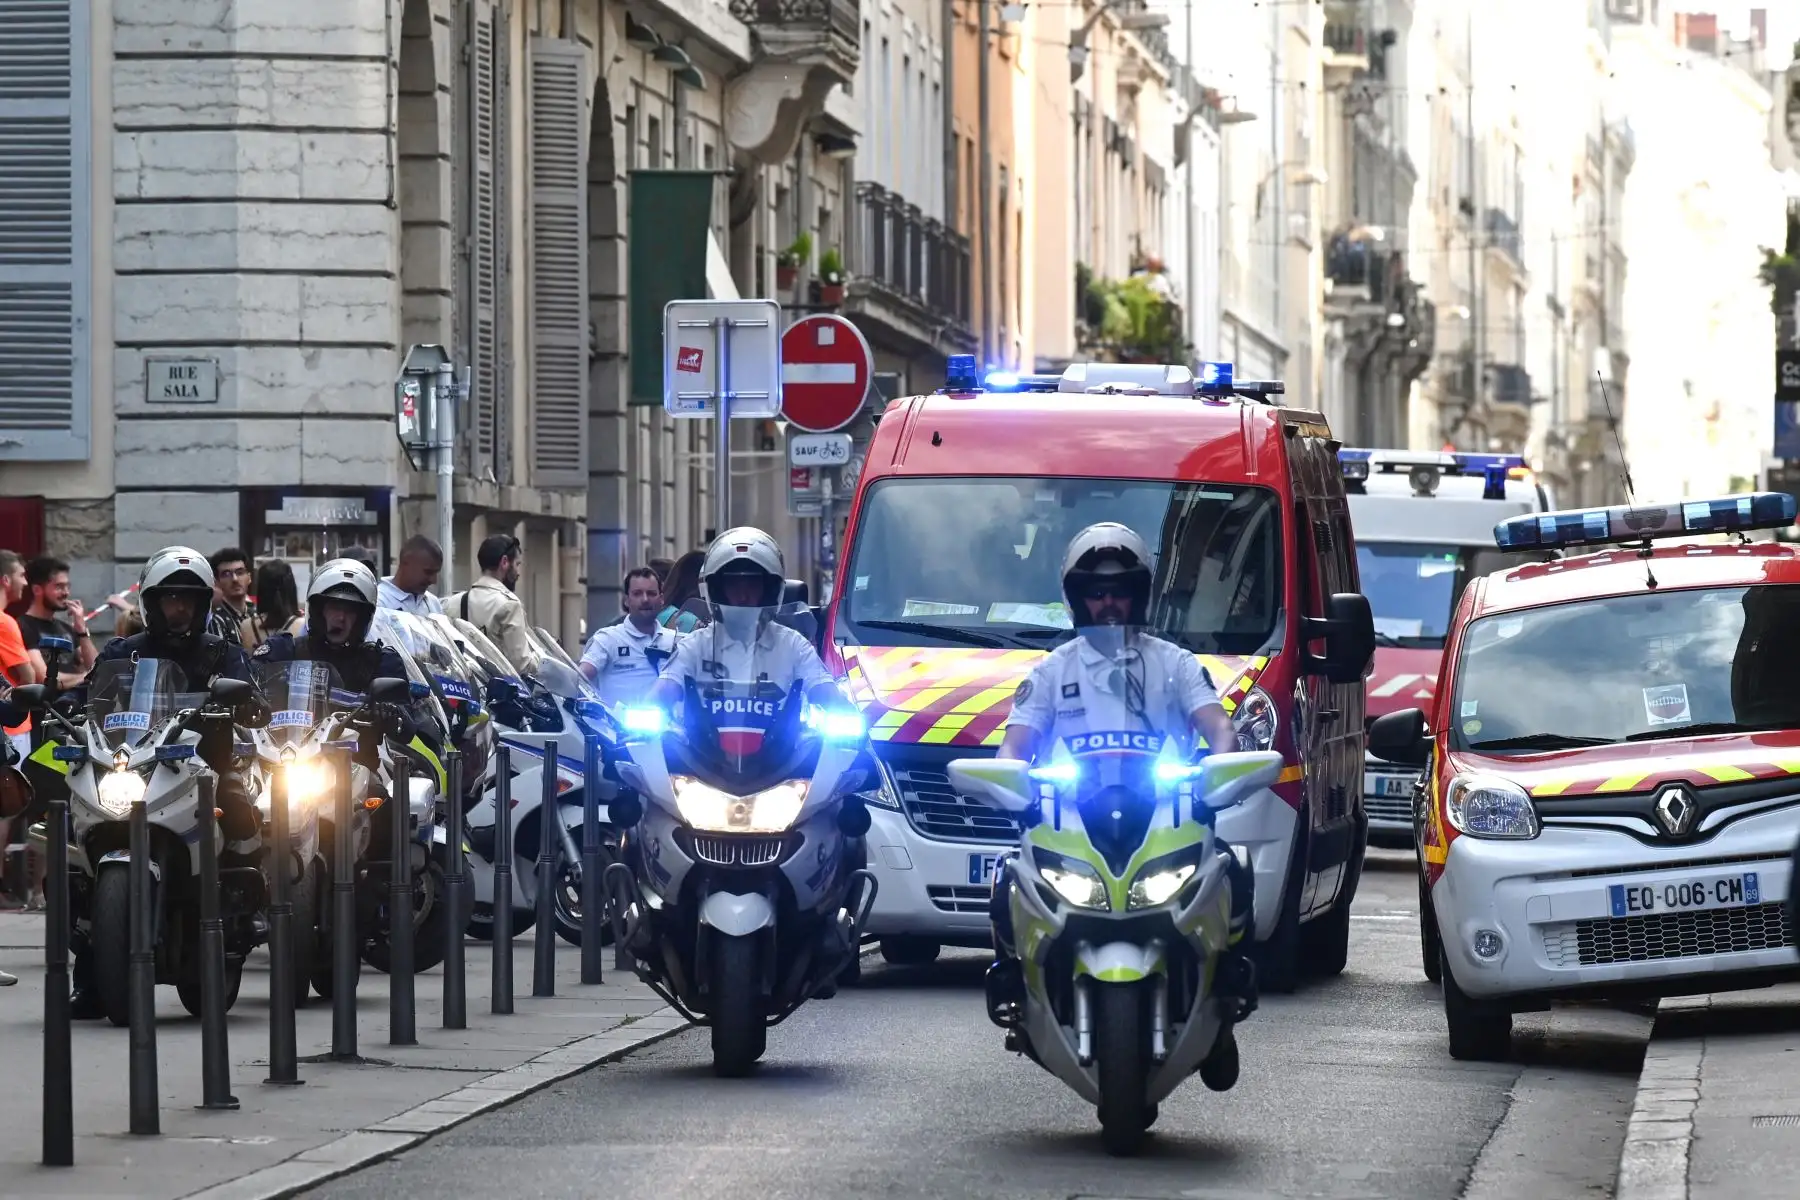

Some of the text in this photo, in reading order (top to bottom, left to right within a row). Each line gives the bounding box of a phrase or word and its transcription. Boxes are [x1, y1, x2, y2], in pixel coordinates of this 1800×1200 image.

[169, 366, 198, 379] RUE
[164, 384, 199, 397] SALA
[795, 446, 818, 456] SAUF
[442, 683, 472, 697] POLICE
[712, 699, 774, 716] POLICE
[105, 712, 148, 725] POLICE
[271, 711, 312, 723] POLICE
[1072, 734, 1161, 751] POLICE
[1627, 878, 1743, 912] EQ-006-CM
[1746, 888, 1758, 900] 69
